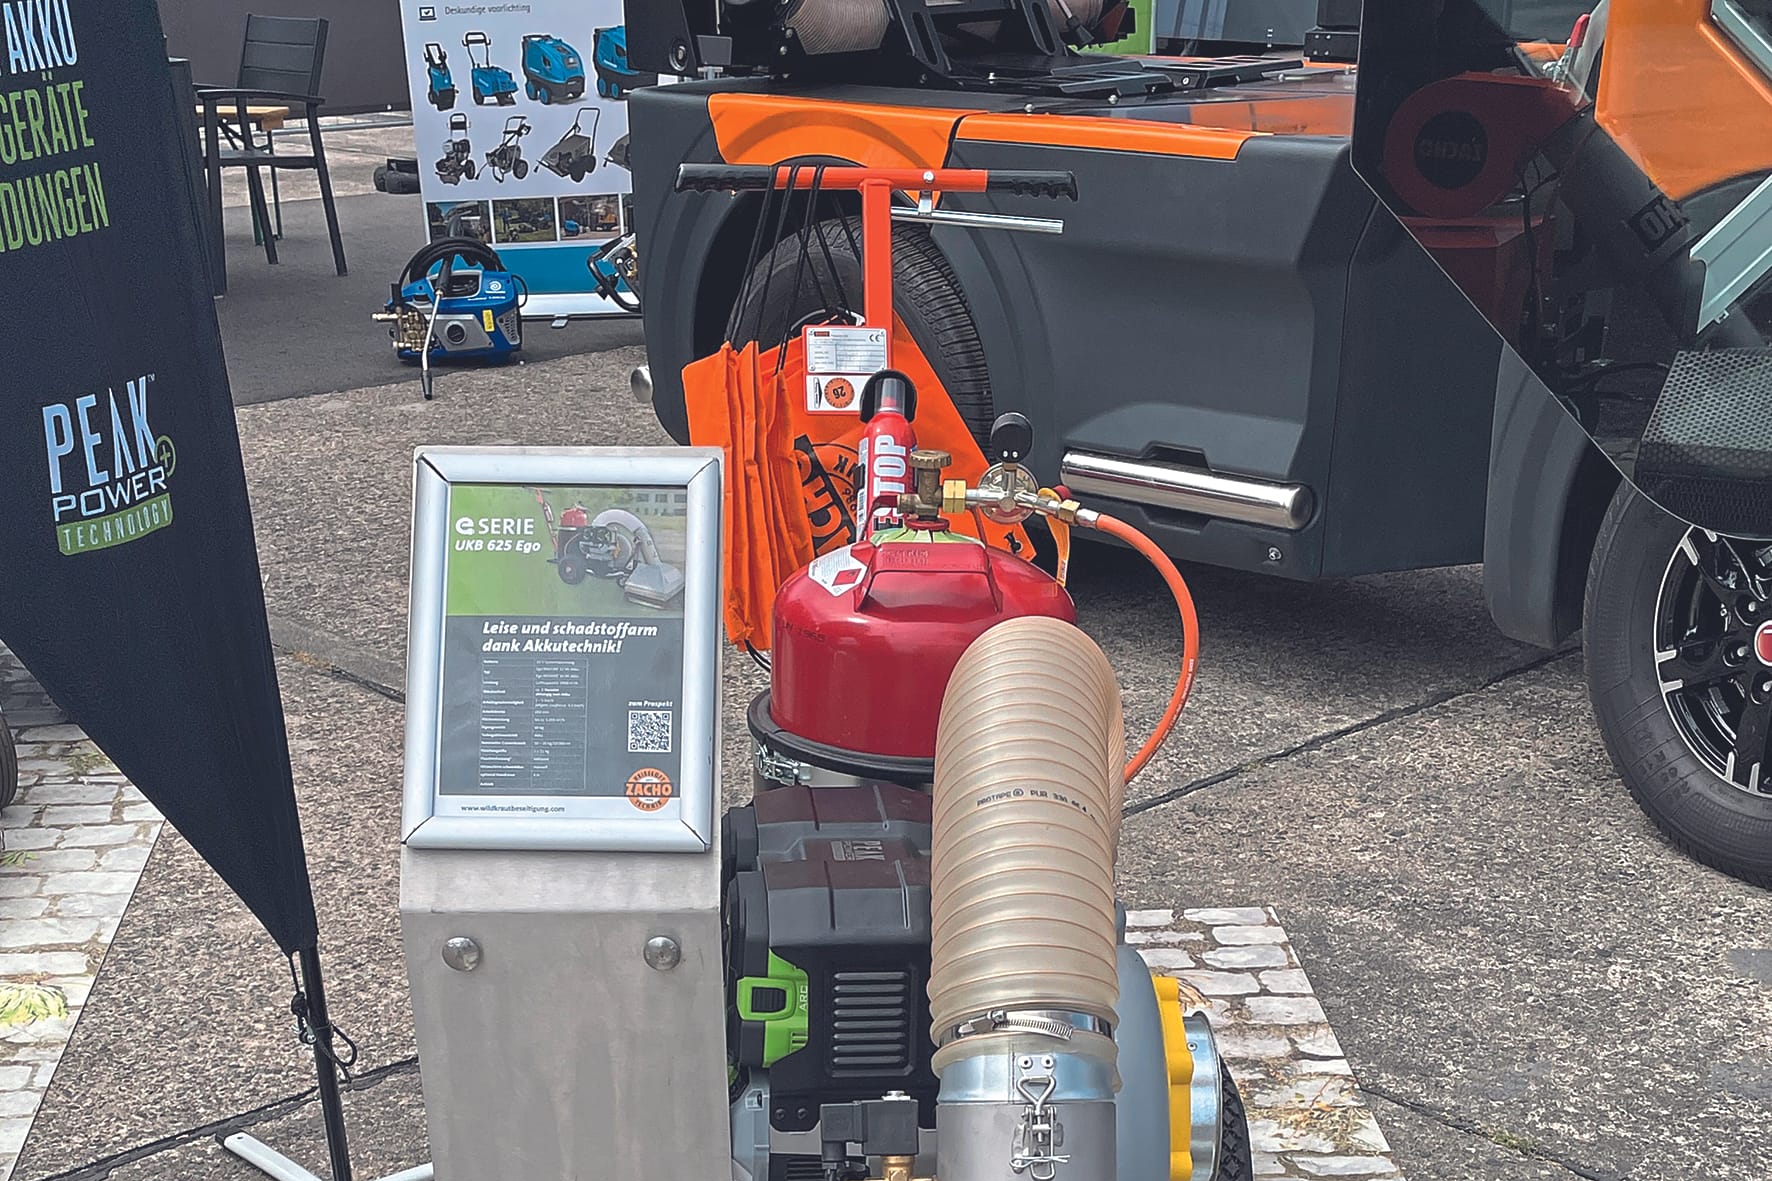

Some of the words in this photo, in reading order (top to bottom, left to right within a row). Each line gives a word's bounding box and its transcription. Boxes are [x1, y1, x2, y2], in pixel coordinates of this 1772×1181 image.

[3, 0, 78, 74] AKKU
[0, 162, 110, 251] DUNGEN
[42, 376, 158, 494] PEAK
[52, 466, 168, 522] POWER
[62, 498, 170, 551] TECHNOLOGY
[455, 540, 484, 552] UKB
[487, 540, 512, 552] 625
[515, 540, 541, 554] Ego
[482, 621, 519, 634] Leise
[521, 622, 551, 635] und
[552, 622, 658, 639] schadstoffarm
[482, 638, 521, 652] dank
[522, 639, 623, 653] Akkutechnik!
[626, 783, 672, 796] ZACHO
[1030, 790, 1048, 798] PUR
[799, 985, 809, 1012] ARC
